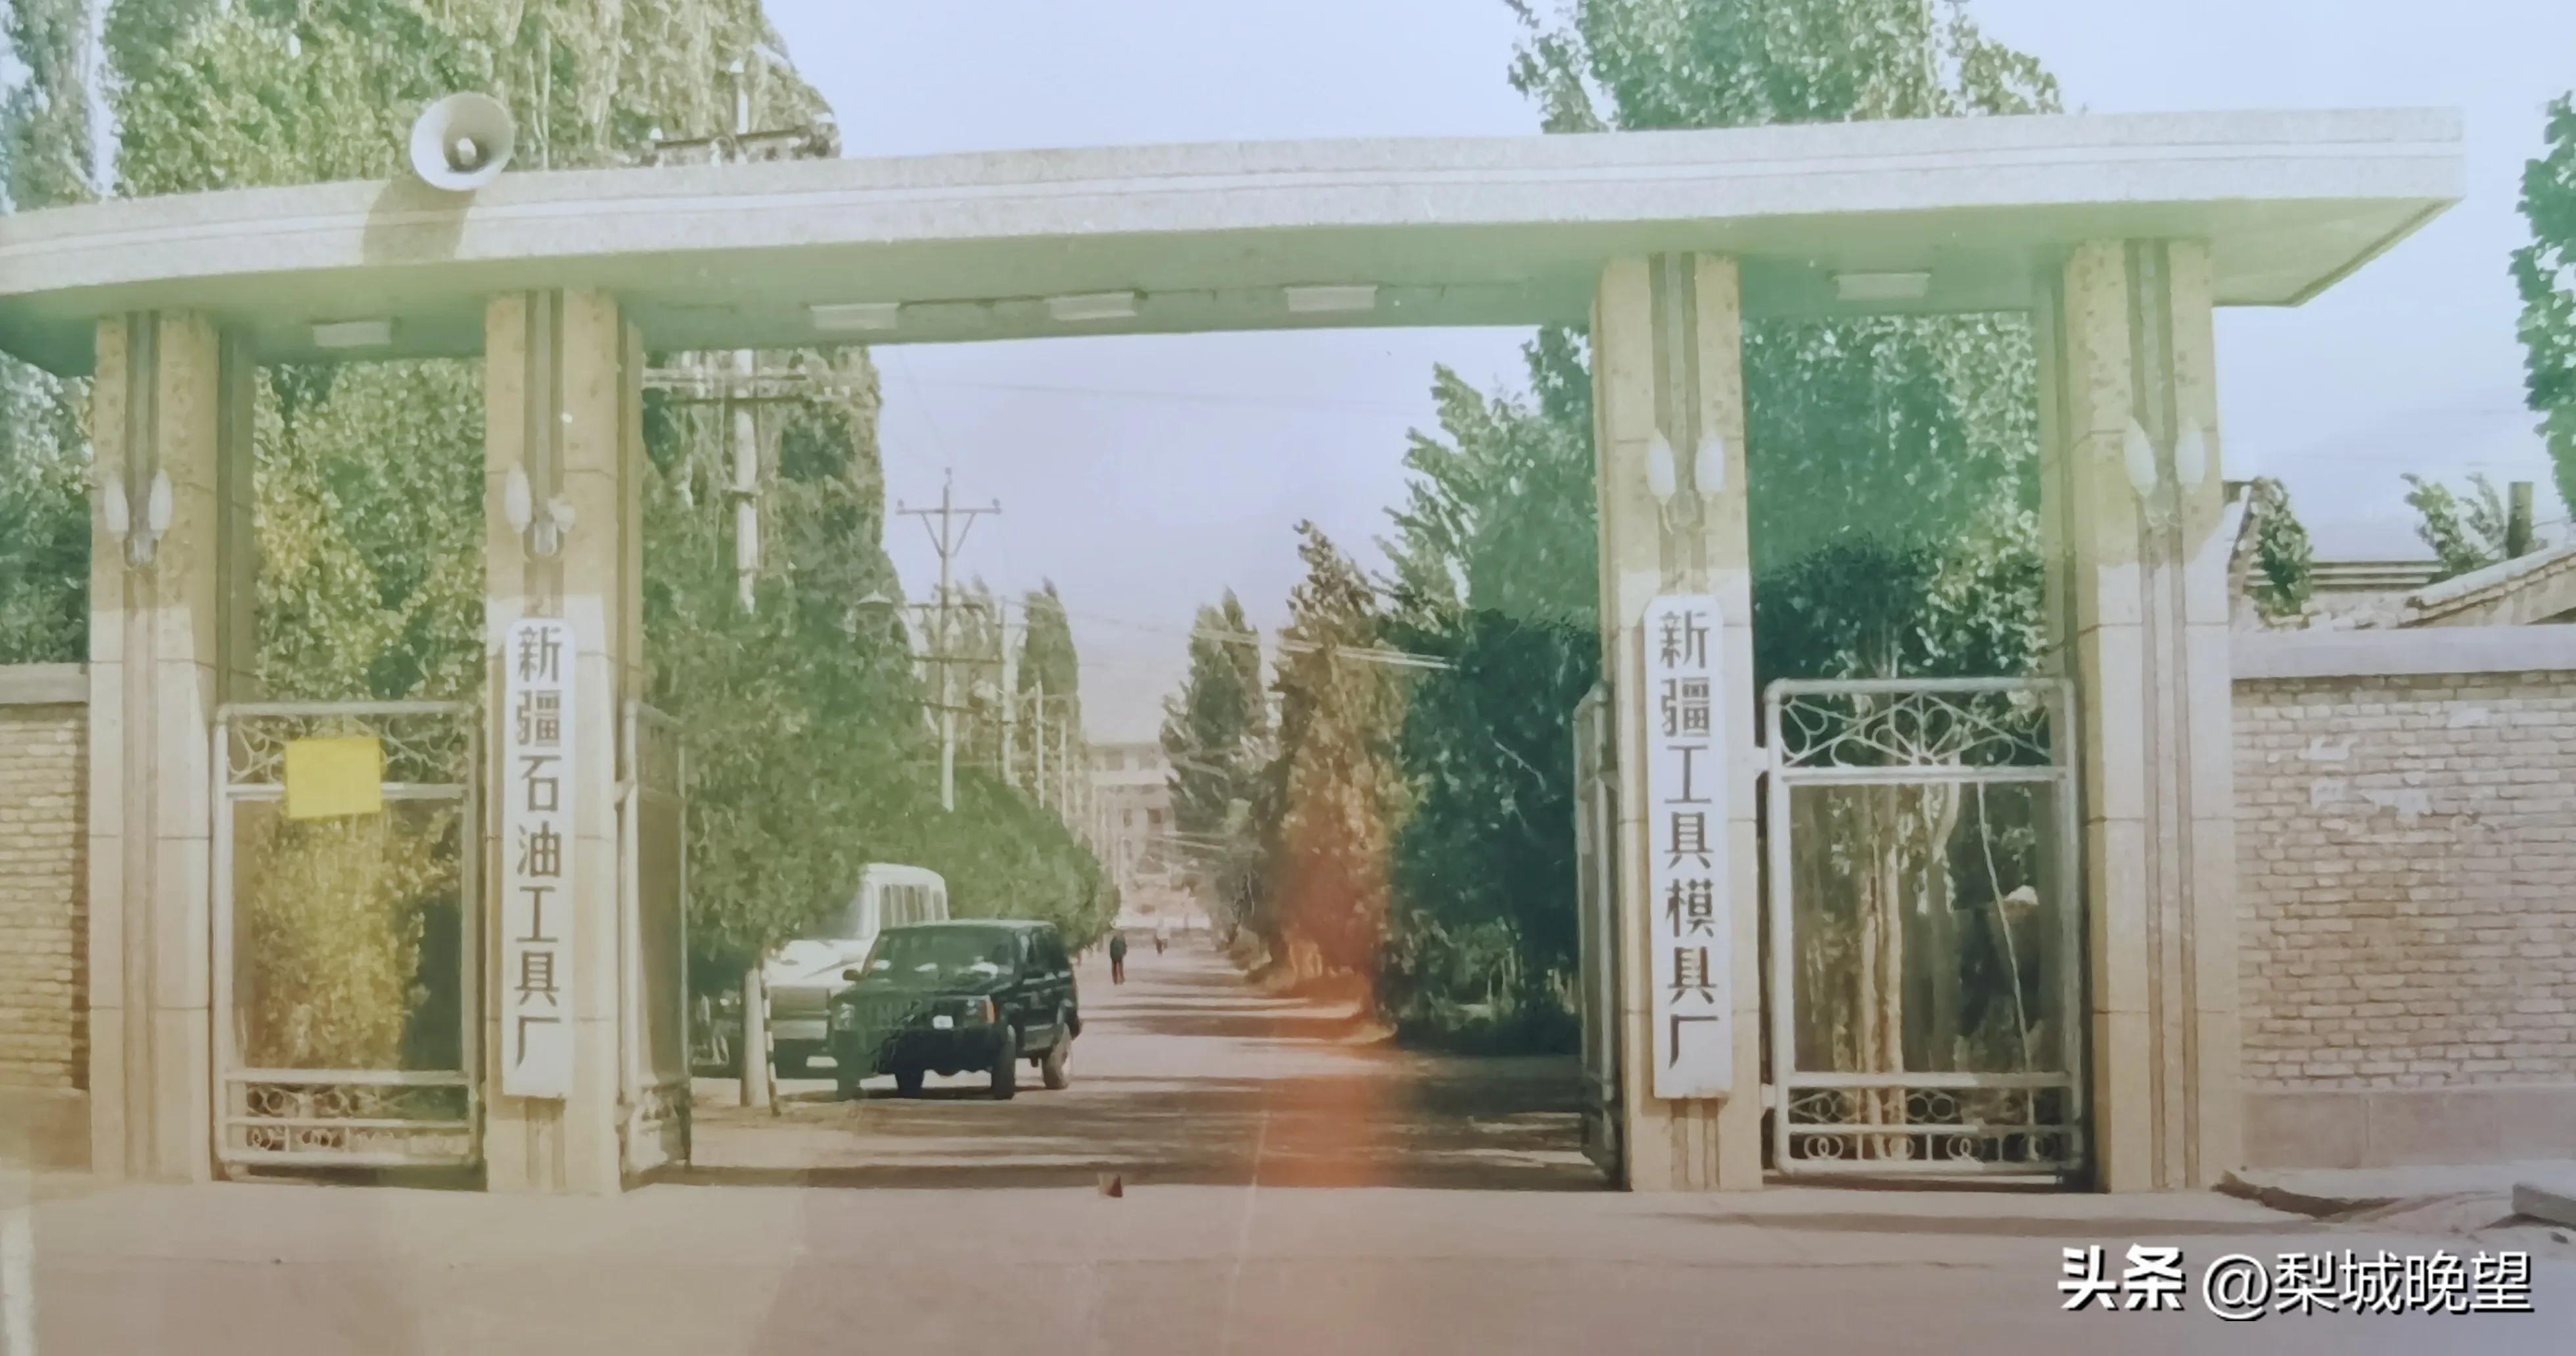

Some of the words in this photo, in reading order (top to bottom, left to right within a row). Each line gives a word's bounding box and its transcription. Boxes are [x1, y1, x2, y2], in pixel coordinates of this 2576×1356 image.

[515, 625, 563, 1070] 新疆石油工具厂
[1659, 610, 1718, 1071] 新疆工具模具厂
